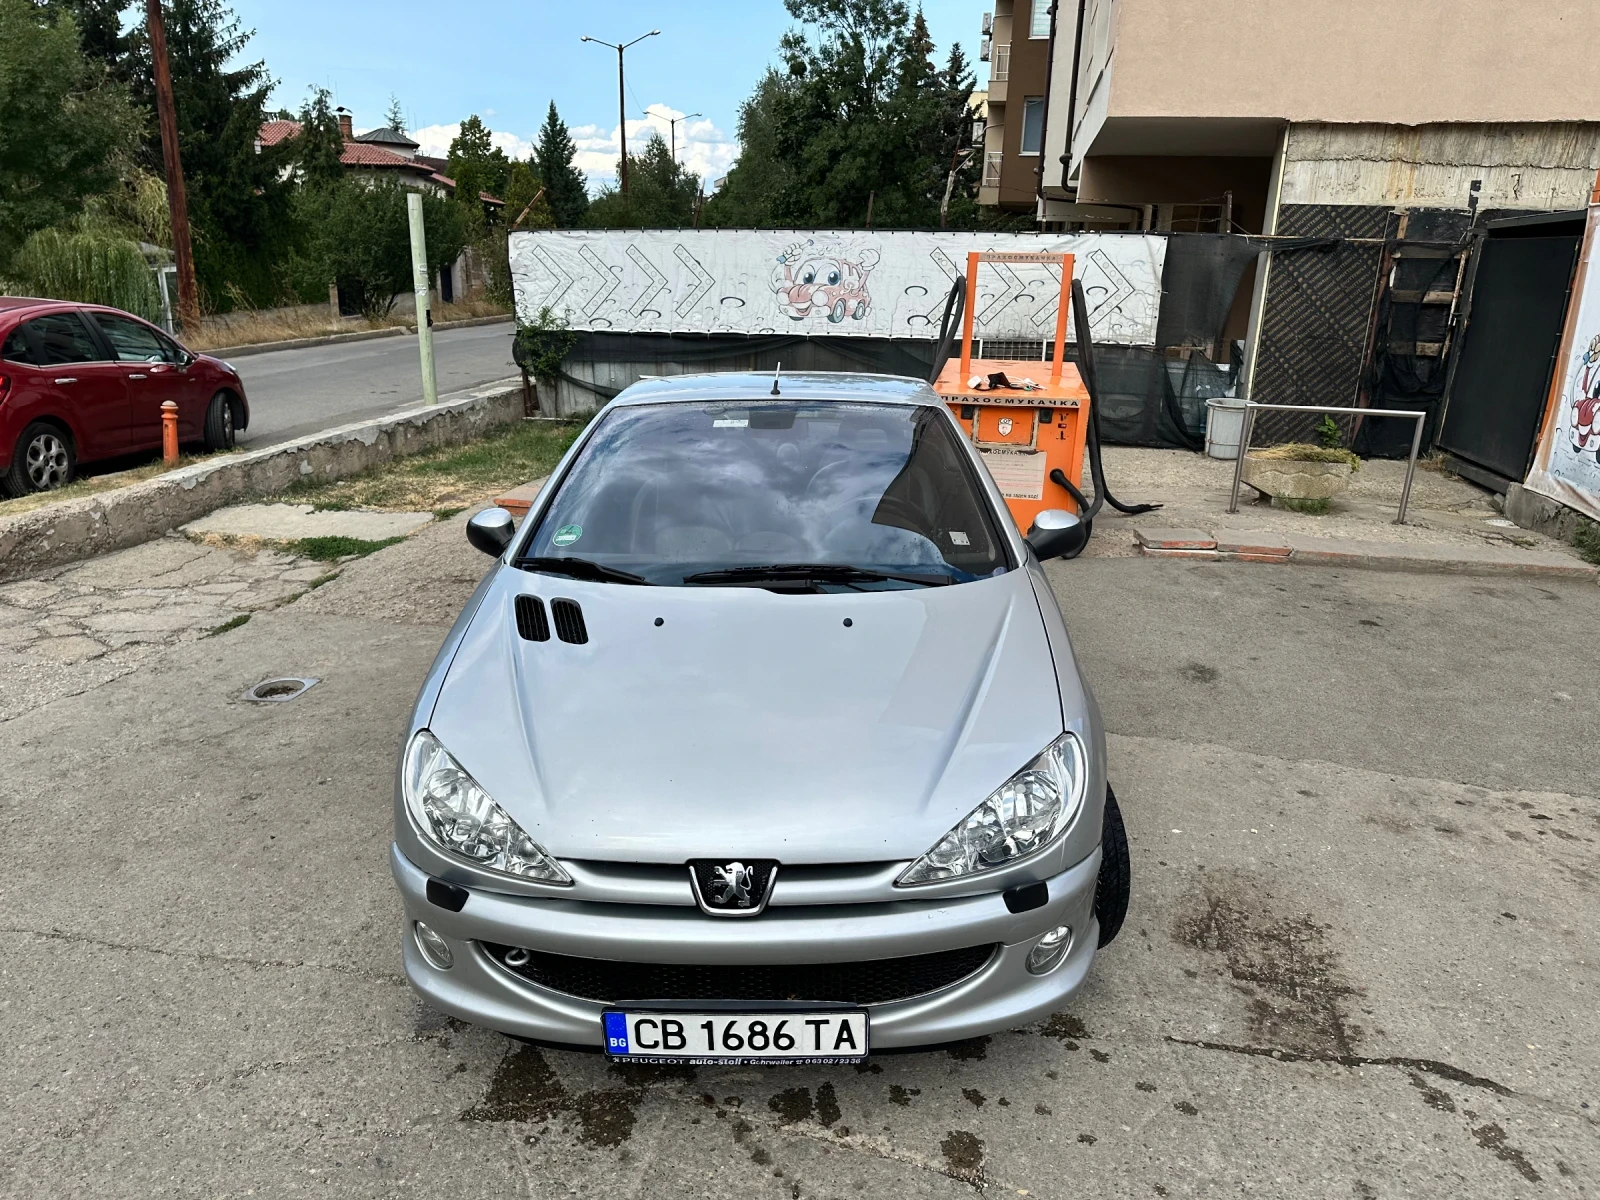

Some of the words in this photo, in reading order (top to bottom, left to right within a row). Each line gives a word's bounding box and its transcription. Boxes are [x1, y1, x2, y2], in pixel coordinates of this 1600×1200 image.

[941, 395, 1079, 407] ПРАХОСМУКАЧКА
[634, 1018, 687, 1050] CB
[700, 1019, 795, 1051] 1686
[805, 1018, 857, 1050] TA
[610, 1037, 626, 1047] BG
[622, 1057, 685, 1065] PEUGEOT
